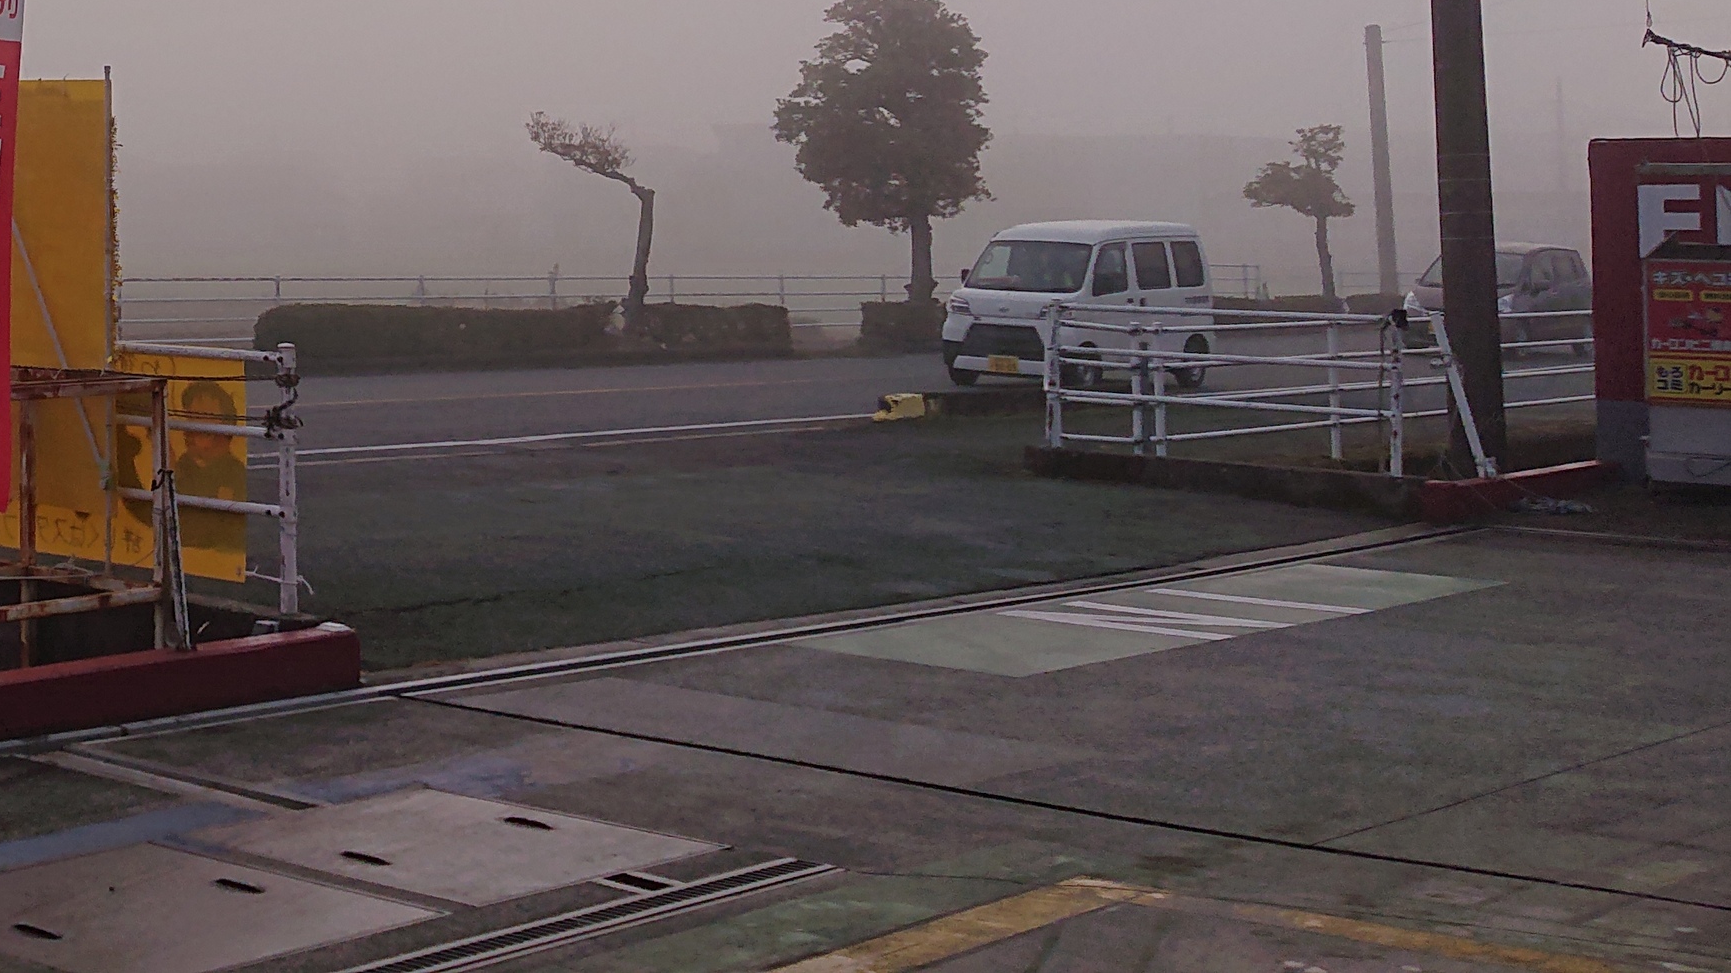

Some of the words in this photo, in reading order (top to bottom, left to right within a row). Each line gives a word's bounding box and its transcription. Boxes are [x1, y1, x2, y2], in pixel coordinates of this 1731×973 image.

[1653, 270, 1731, 286] キズ・ヘコ
